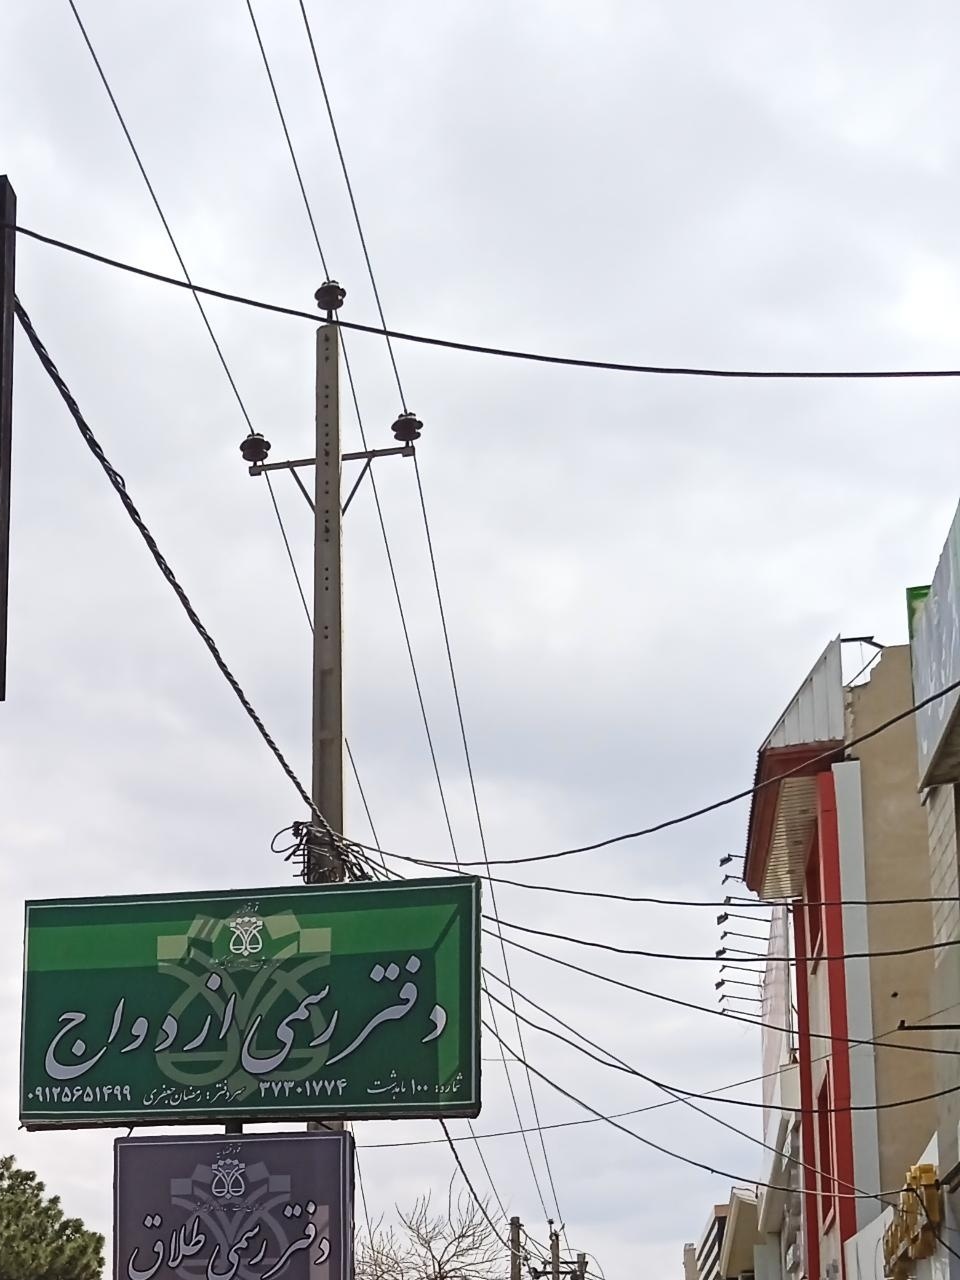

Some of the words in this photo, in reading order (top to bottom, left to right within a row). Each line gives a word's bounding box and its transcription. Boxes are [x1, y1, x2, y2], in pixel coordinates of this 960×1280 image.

[44, 972, 238, 1081] ازدواج
[241, 984, 339, 1074] رسمی
[326, 955, 448, 1066] دفتر
[27, 1085, 132, 1103] ۰۹۱۲۵۶۵۱۴۹۹
[259, 1078, 348, 1097] ۳۷۳۰۱۷۷۴
[260, 1200, 331, 1280] دفتر
